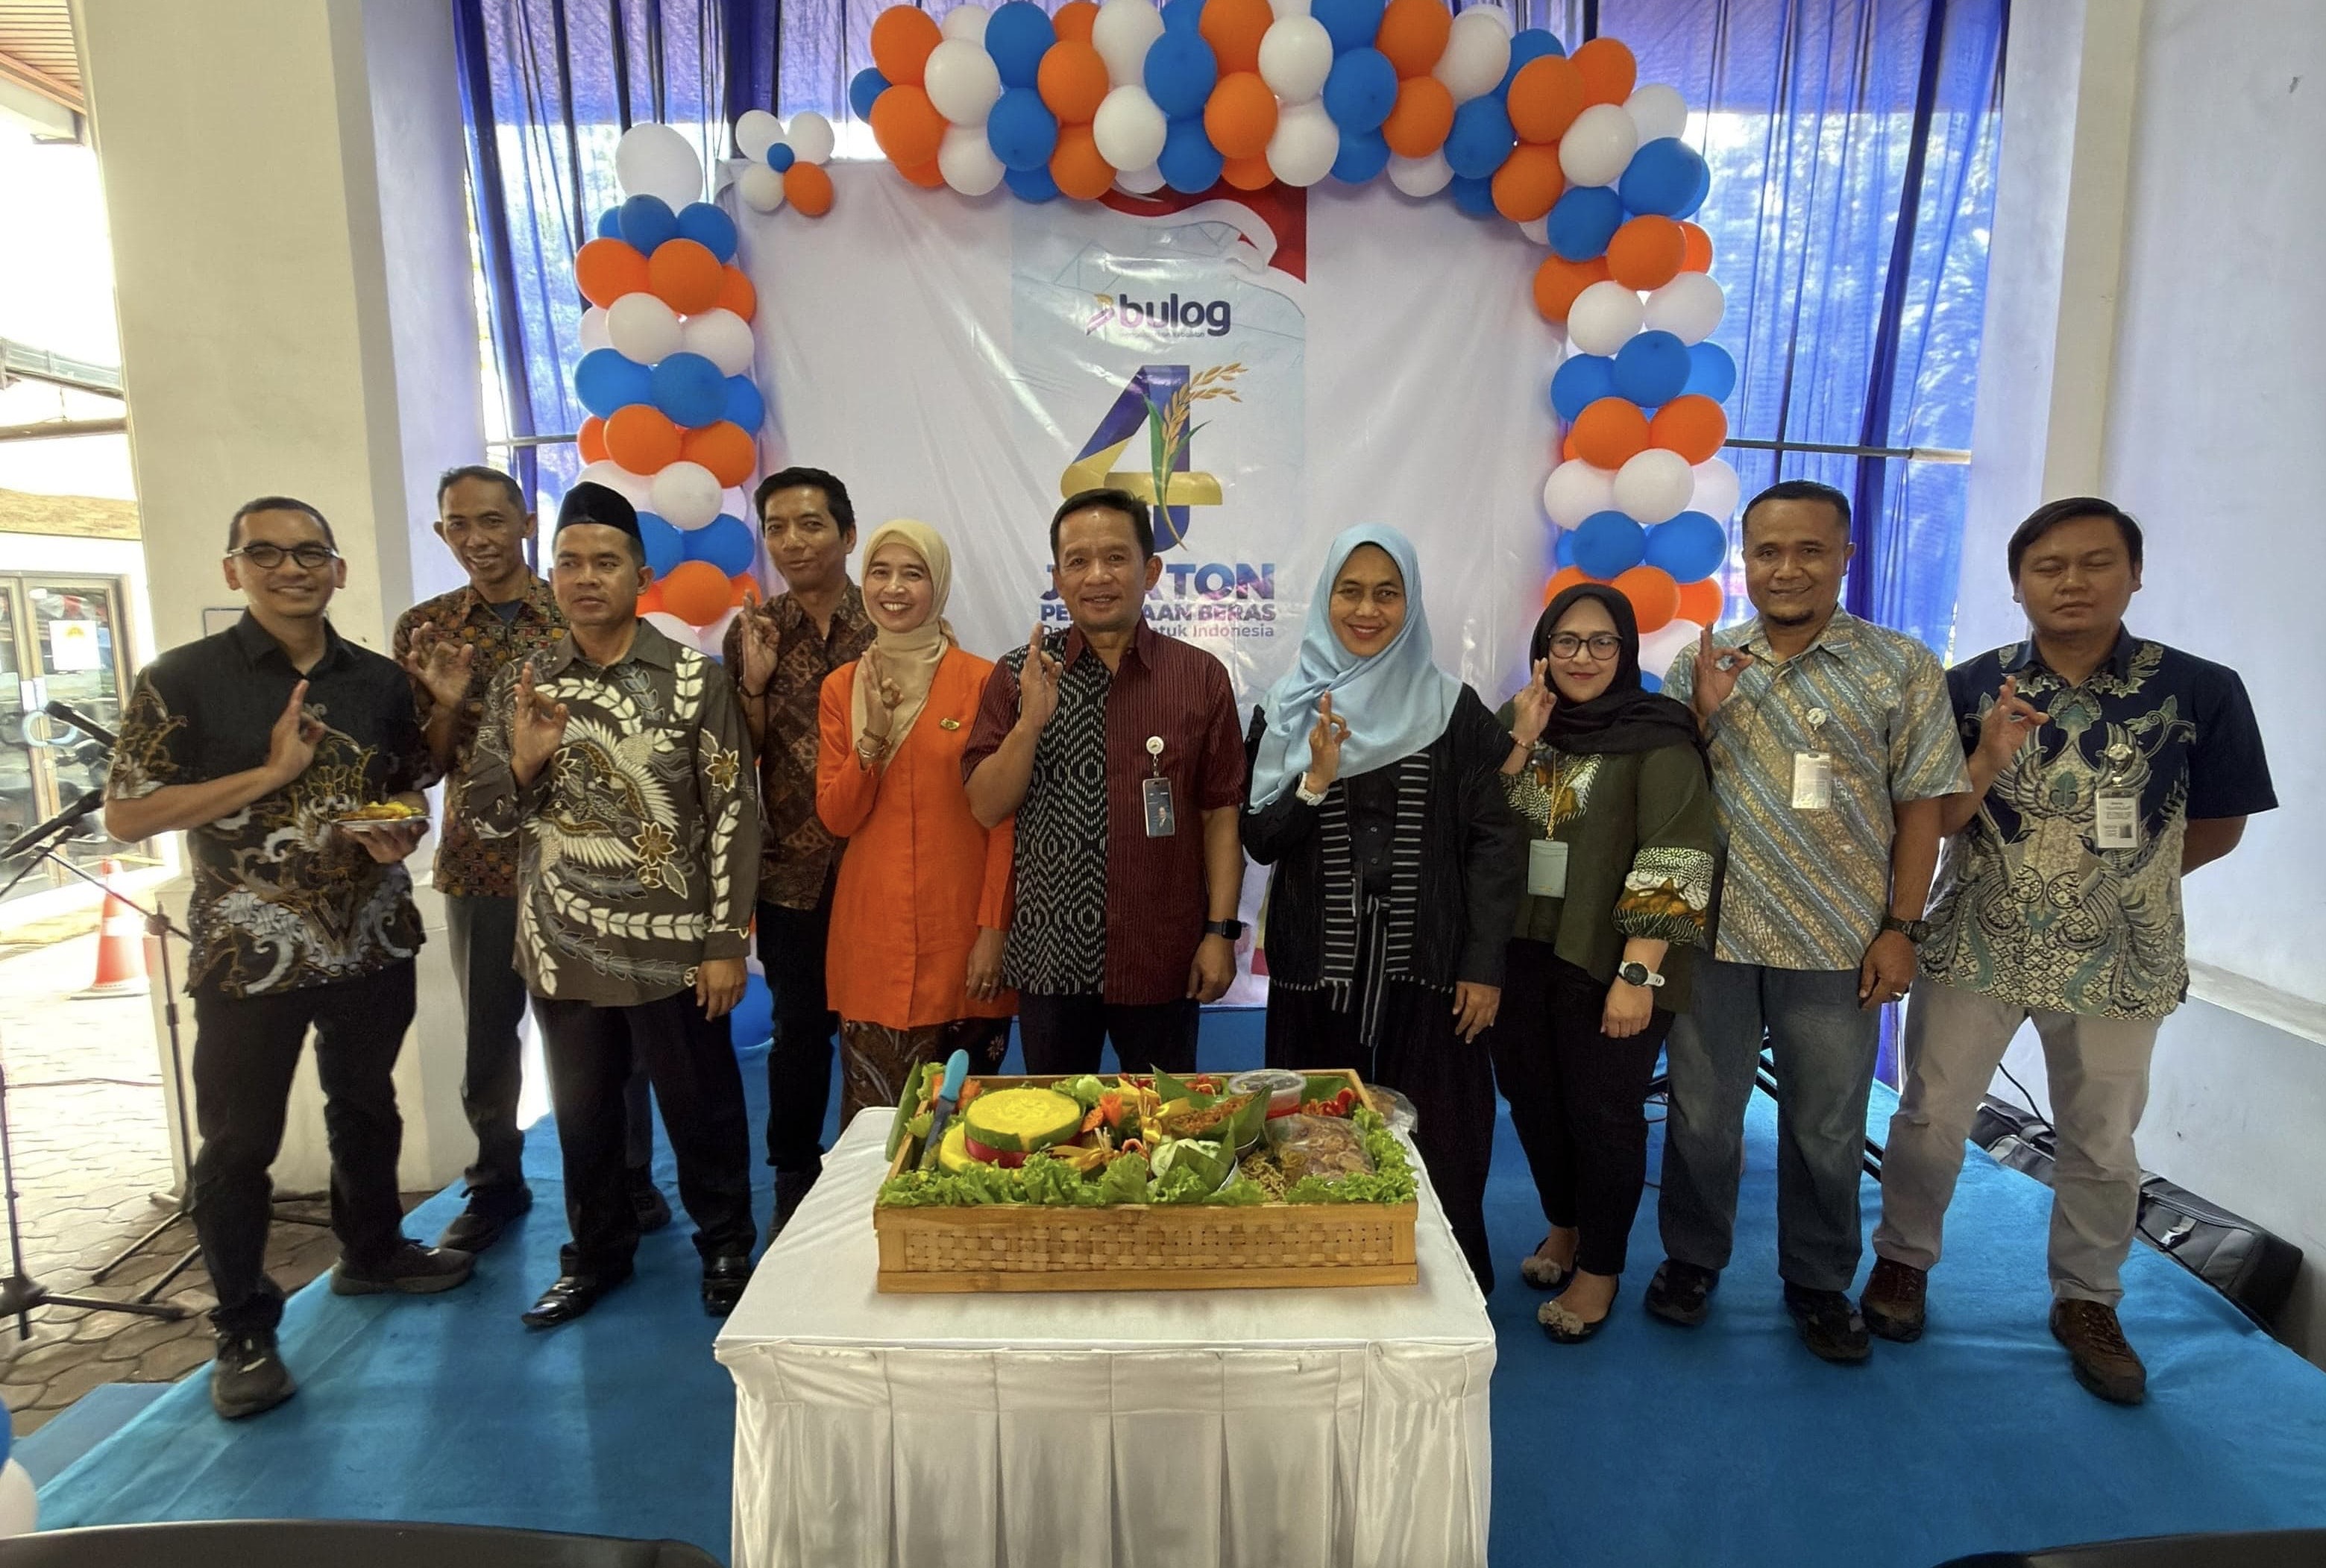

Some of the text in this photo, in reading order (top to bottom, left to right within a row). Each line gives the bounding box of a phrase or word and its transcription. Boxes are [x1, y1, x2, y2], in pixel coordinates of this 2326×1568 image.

[1119, 293, 1231, 337] bulog
[1060, 365, 1223, 552] 4
[1166, 563, 1275, 600] TON
[1041, 604, 1277, 621] PEAAN BERAS
[1192, 623, 1274, 637] Indonesia
